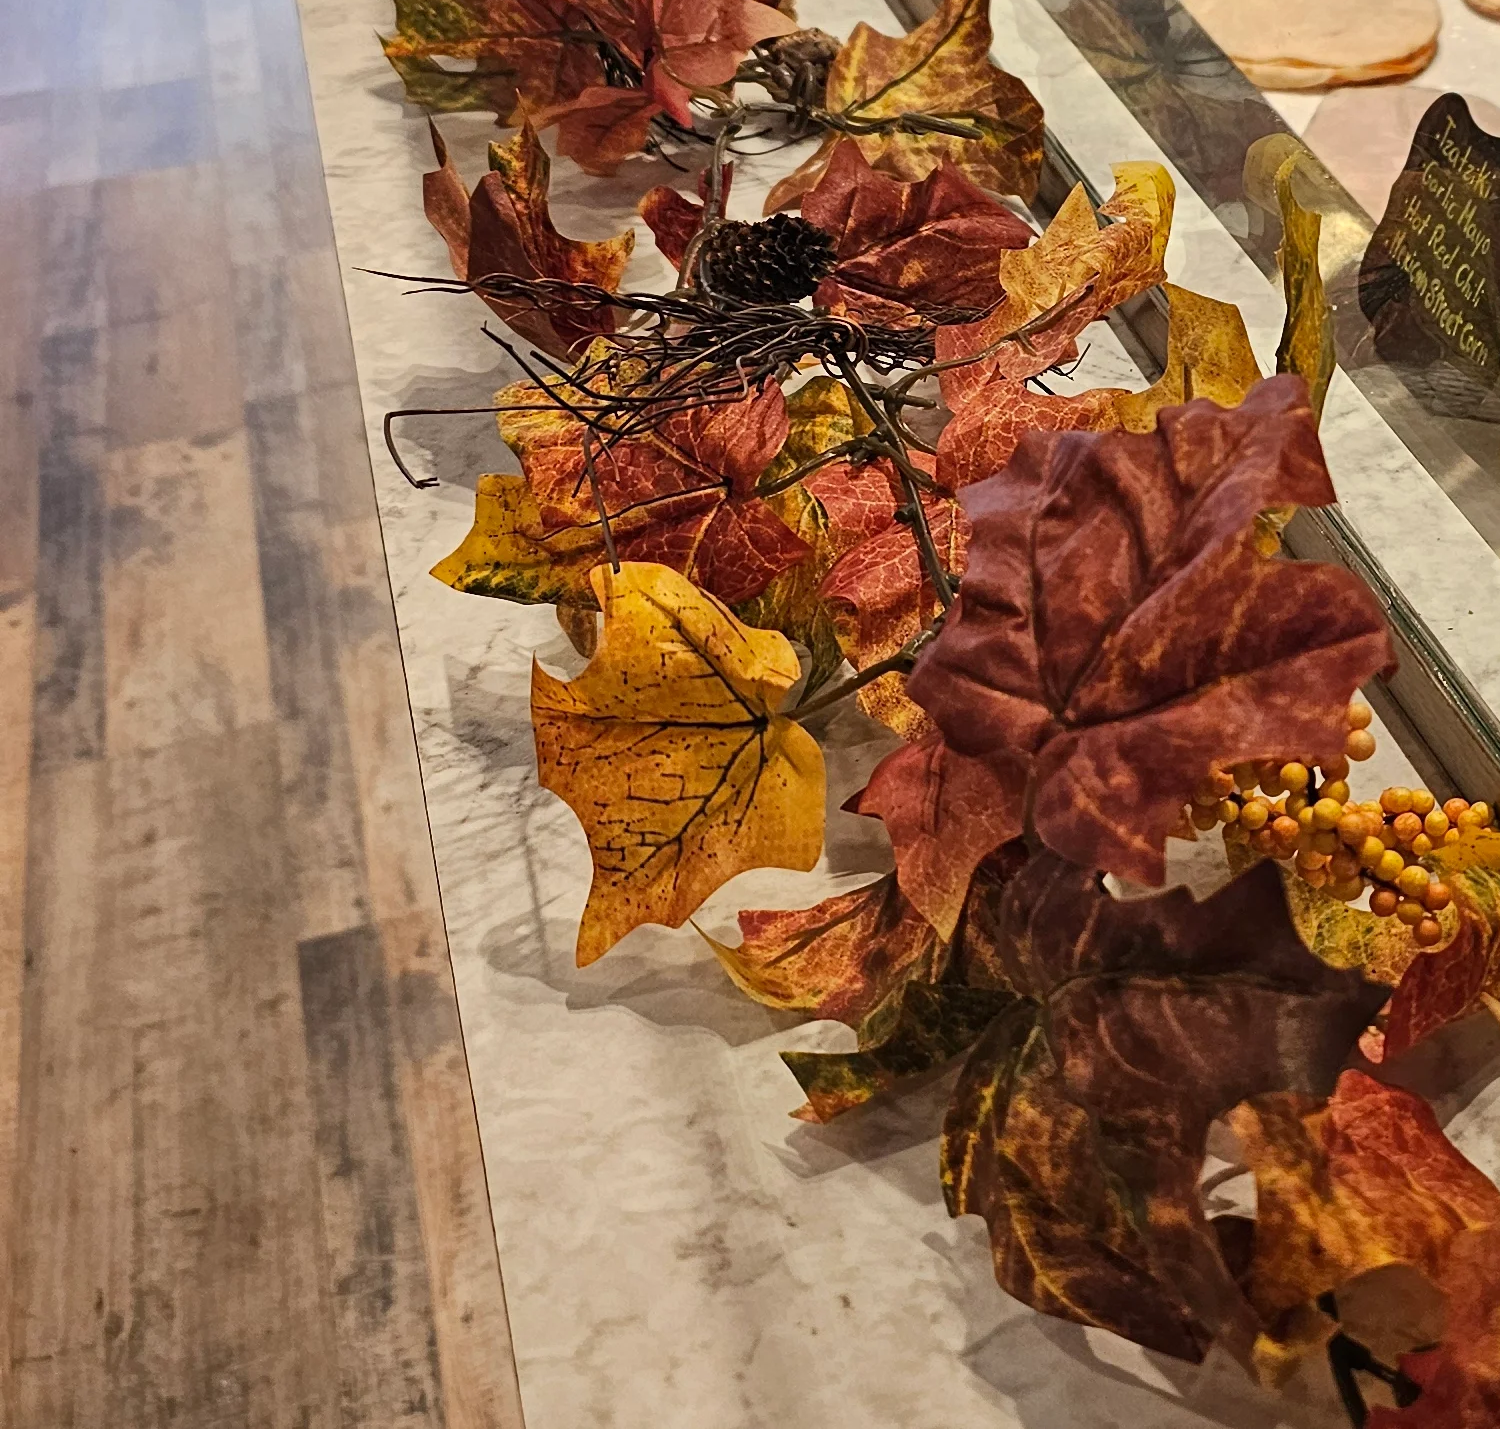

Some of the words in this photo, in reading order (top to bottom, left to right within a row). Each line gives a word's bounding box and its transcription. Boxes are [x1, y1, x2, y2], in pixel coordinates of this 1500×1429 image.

[1438, 115, 1497, 200] Tzatziki
[1404, 198, 1430, 235] Hot
[1427, 223, 1459, 269] Red
[1455, 263, 1486, 308] Chili
[1422, 160, 1455, 218] Garlic
[1460, 199, 1491, 256] Mayo
[1424, 278, 1461, 337] Street
[1458, 323, 1490, 367] Corn
